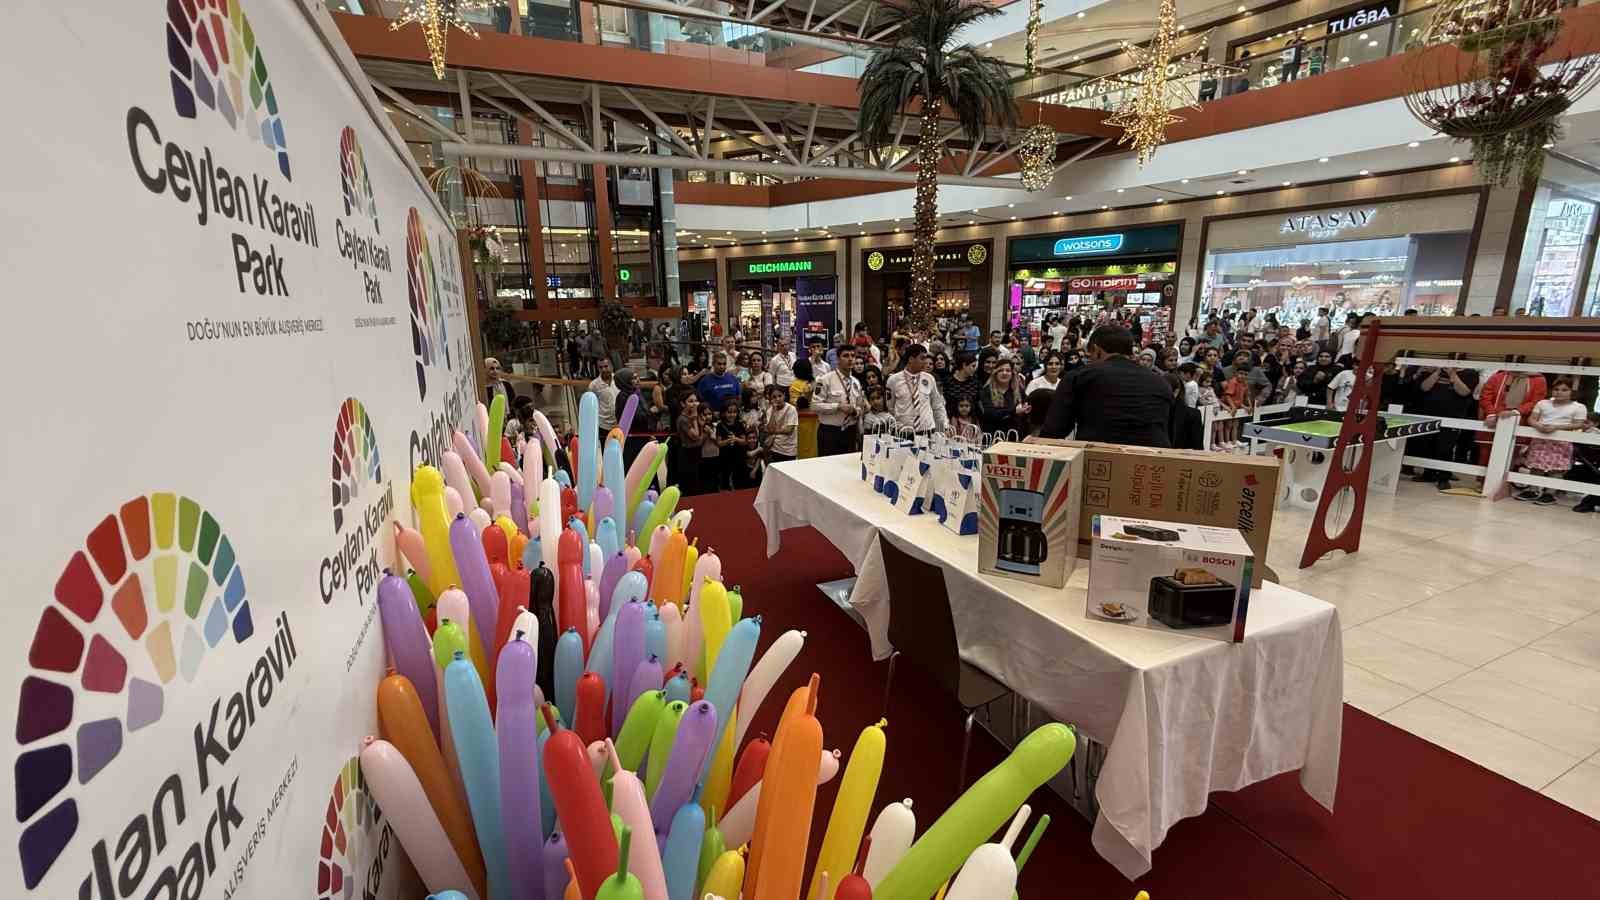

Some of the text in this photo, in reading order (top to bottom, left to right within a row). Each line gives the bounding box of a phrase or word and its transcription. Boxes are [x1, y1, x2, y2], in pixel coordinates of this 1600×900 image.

[1329, 6, 1391, 34] TUĞBA
[1038, 84, 1096, 105] TIFFANY
[126, 106, 319, 248] Ceylan Karavil
[1281, 208, 1376, 234] ATASAY
[336, 218, 369, 270] Ceylan
[1063, 238, 1113, 251] watsons
[231, 232, 289, 297] Park
[749, 261, 812, 273] DEICHMANN
[363, 270, 383, 305] Park
[186, 317, 242, 341] DOĞU'NUN
[242, 320, 254, 336] EN
[985, 463, 1025, 479] VESTEL
[1237, 487, 1256, 535] arçelik
[320, 525, 364, 605] Ceylan
[364, 479, 395, 545] Karavil
[355, 546, 381, 607] Park
[1202, 556, 1236, 567] BOSCH
[194, 610, 297, 795] Karavil
